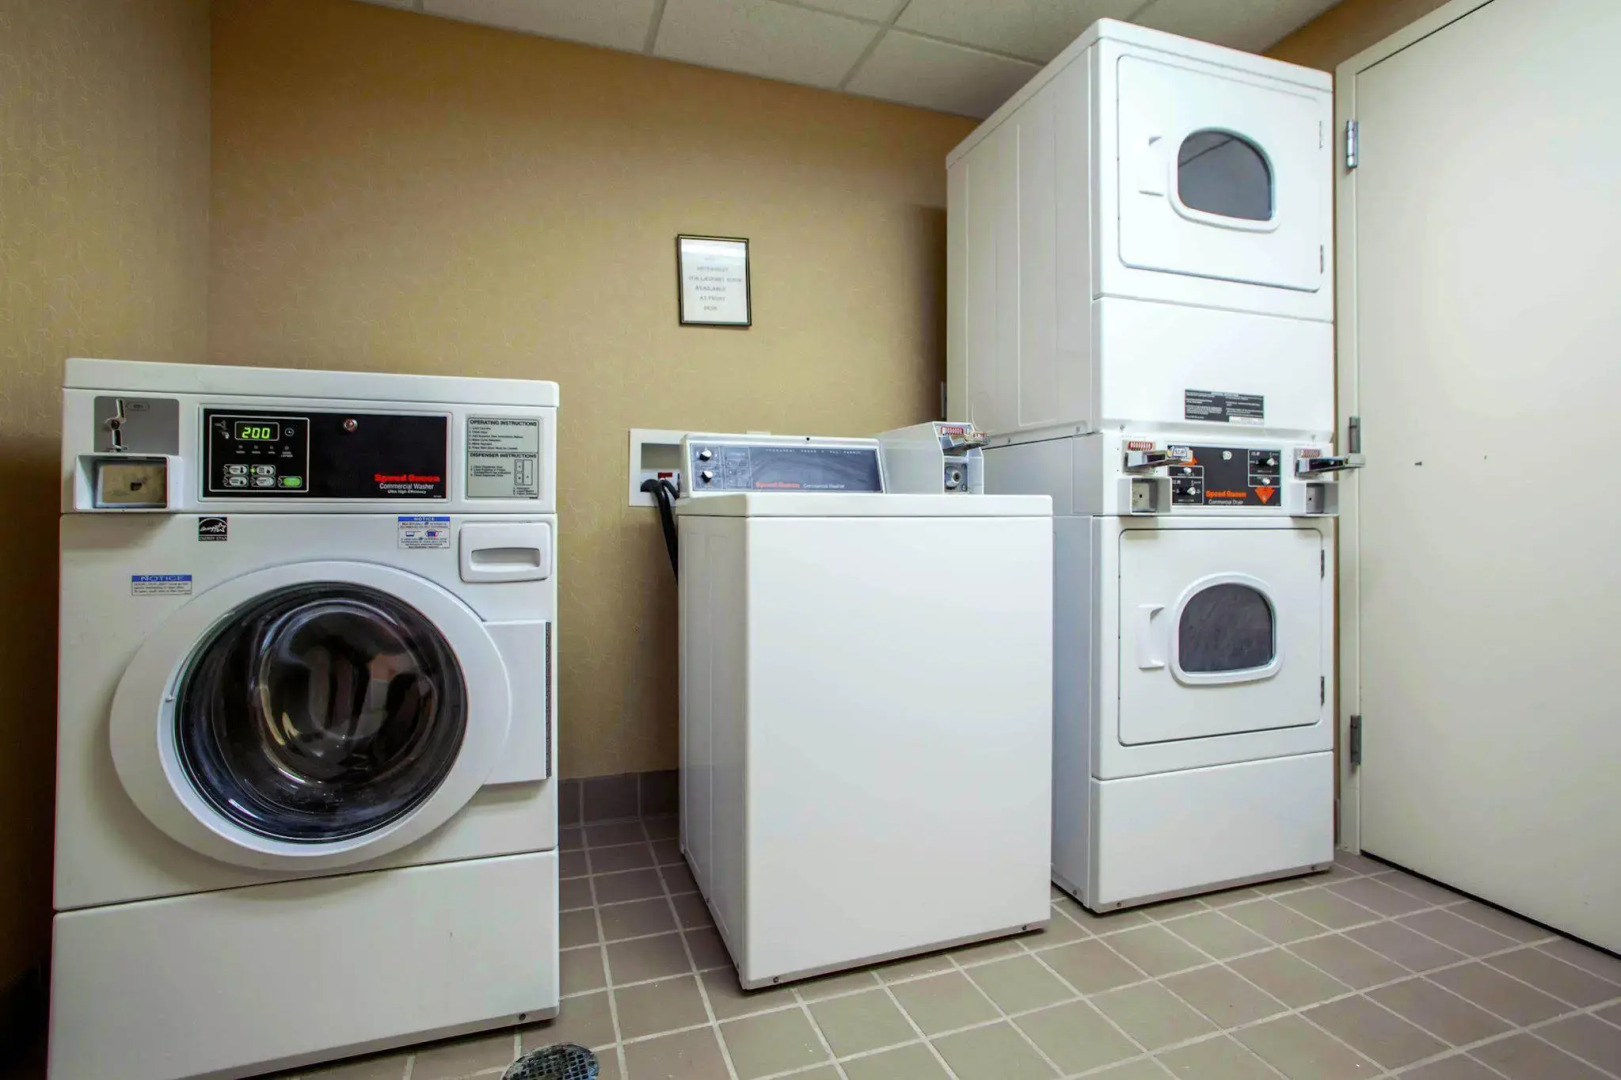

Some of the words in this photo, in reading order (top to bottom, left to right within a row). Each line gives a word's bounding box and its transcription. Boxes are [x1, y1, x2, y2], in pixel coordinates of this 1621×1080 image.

[241, 426, 271, 439] 200
[374, 474, 407, 483] Speed
[408, 474, 440, 482] Queen
[1205, 490, 1226, 498] Speed
